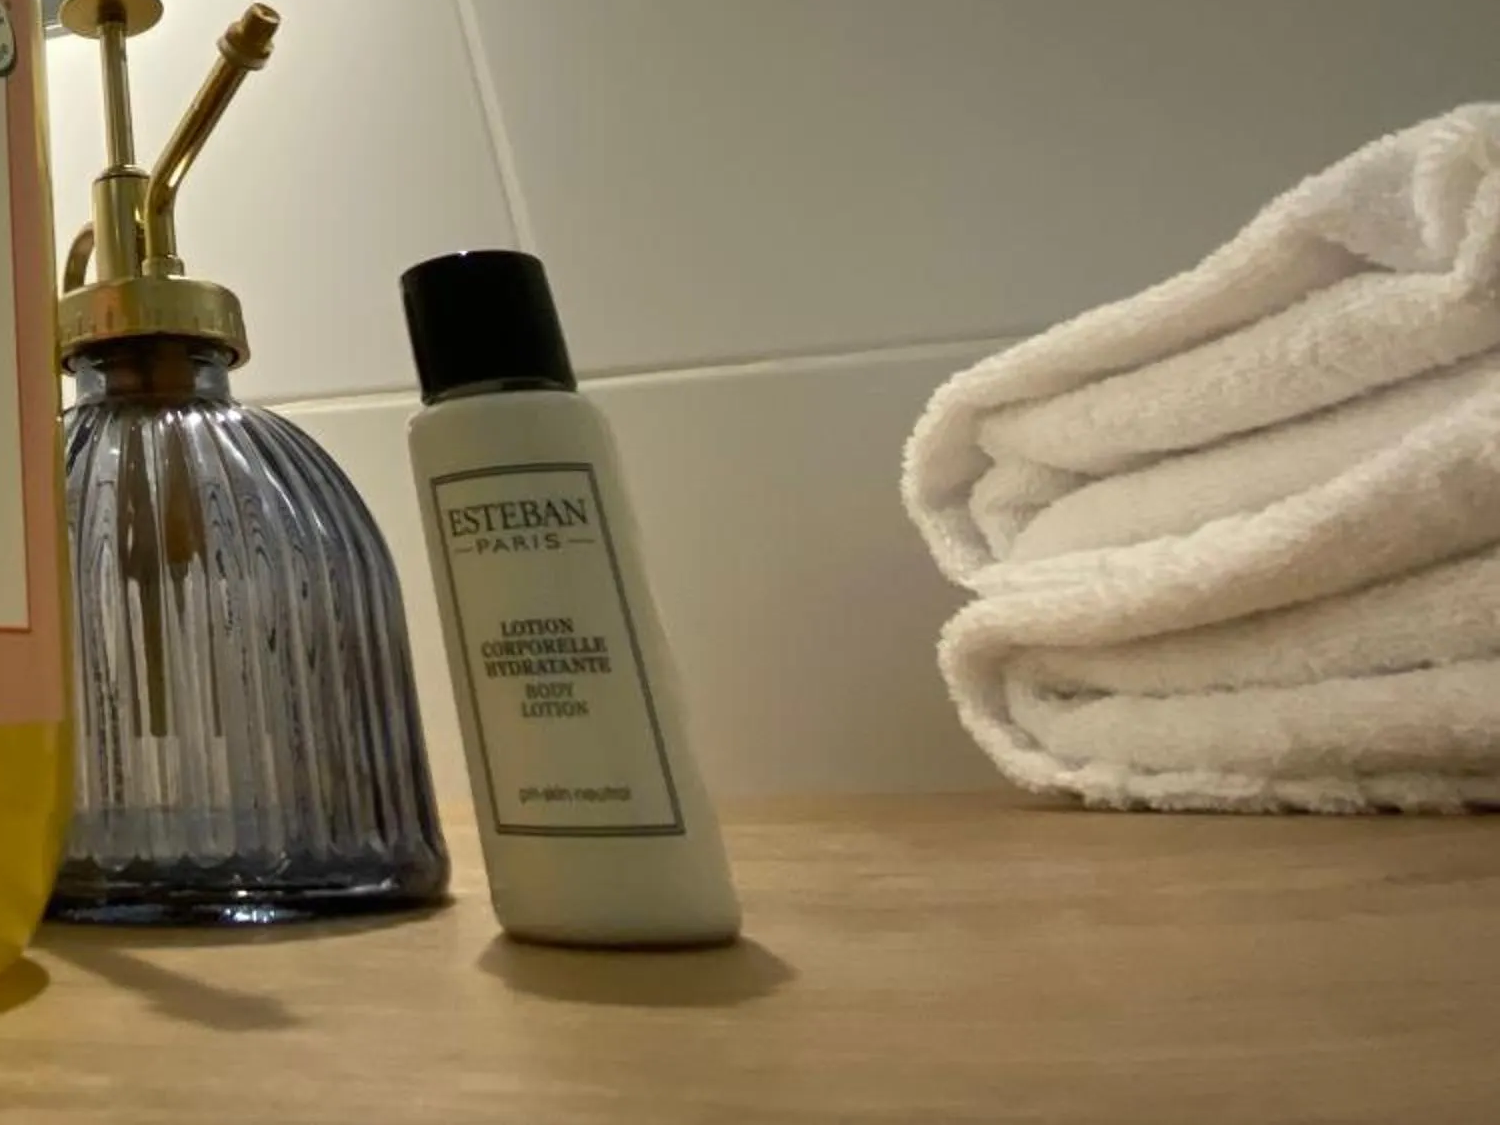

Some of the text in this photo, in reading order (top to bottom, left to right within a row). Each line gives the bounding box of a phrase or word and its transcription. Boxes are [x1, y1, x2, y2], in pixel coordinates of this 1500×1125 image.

[448, 498, 590, 538] ESTEBAN
[476, 533, 562, 555] PARIS
[500, 618, 574, 638] LOTION
[481, 636, 608, 658] CORPORELLE
[484, 655, 612, 679] HYDRATANTE
[525, 682, 575, 700] BODY
[521, 700, 589, 720] LOTION
